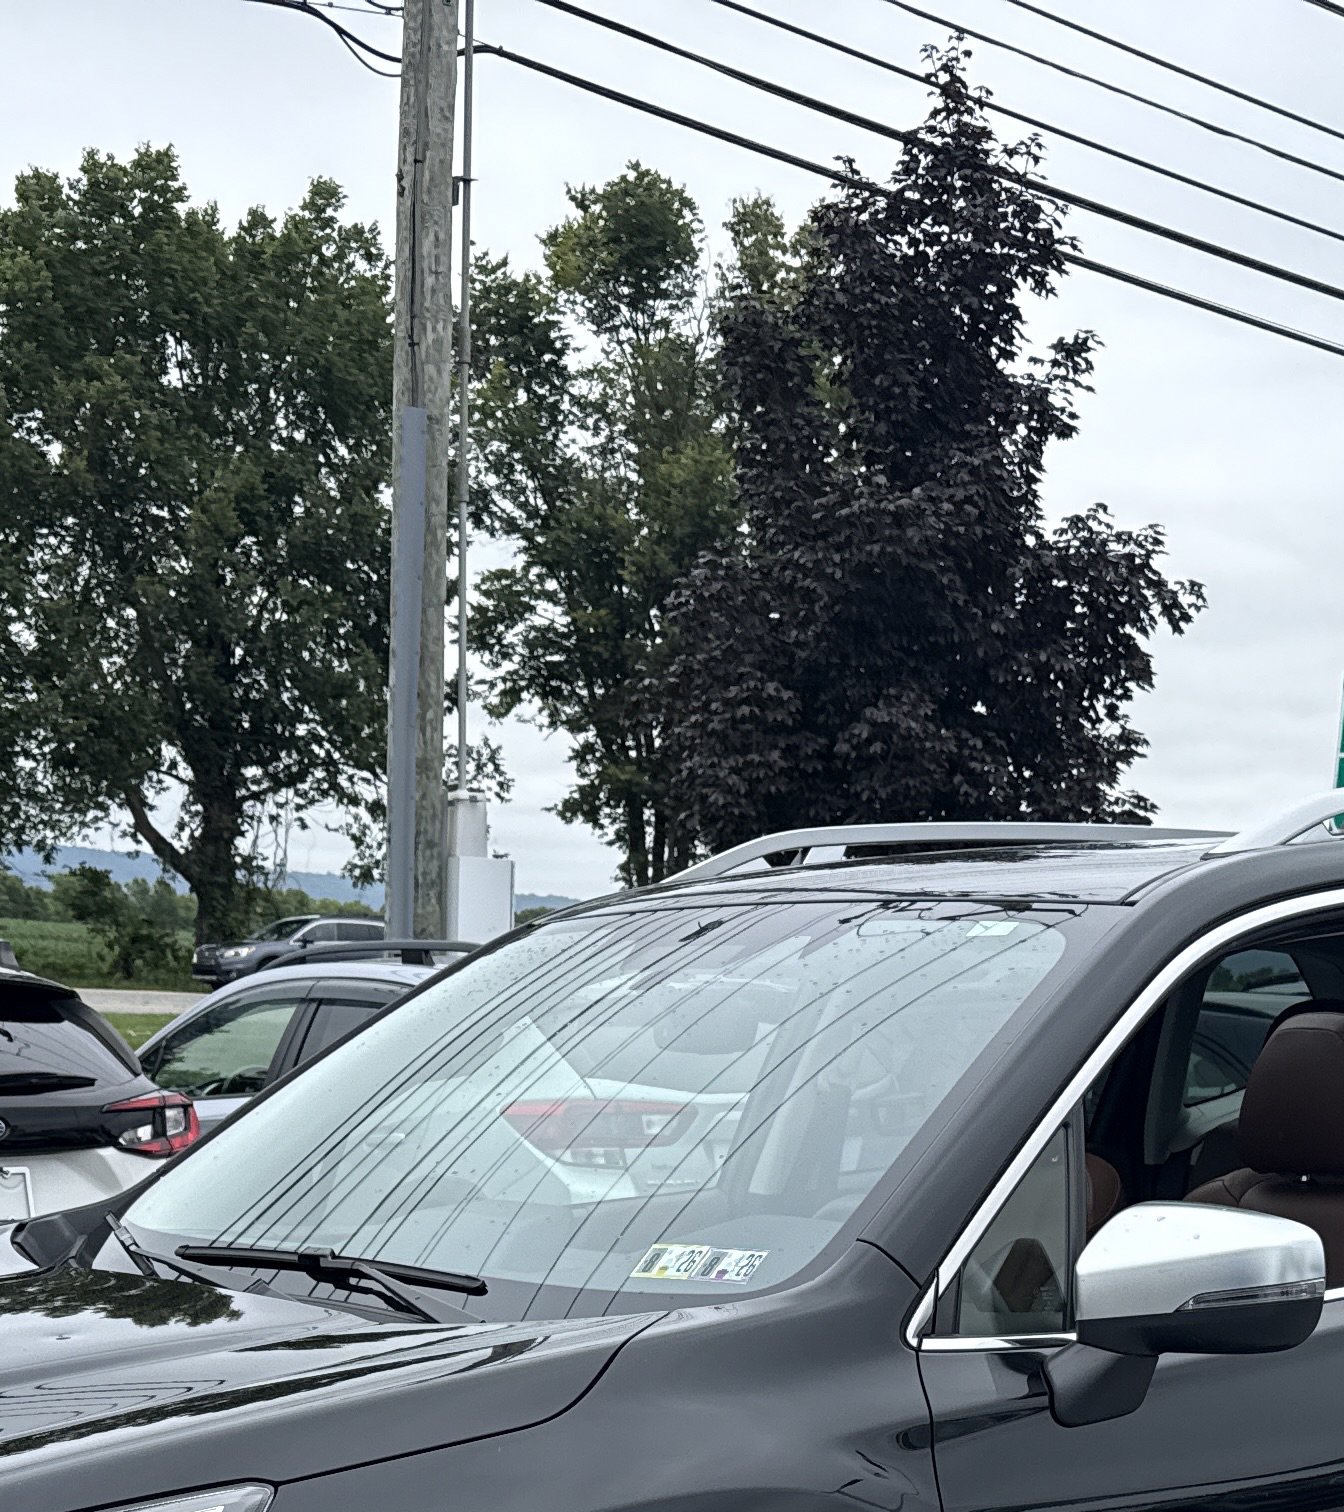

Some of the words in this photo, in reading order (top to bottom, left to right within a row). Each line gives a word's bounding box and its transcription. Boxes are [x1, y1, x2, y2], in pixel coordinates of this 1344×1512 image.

[642, 1252, 661, 1273] 8
[676, 1249, 703, 1273] 26
[700, 1256, 721, 1277] 8
[735, 1253, 763, 1277] 26
